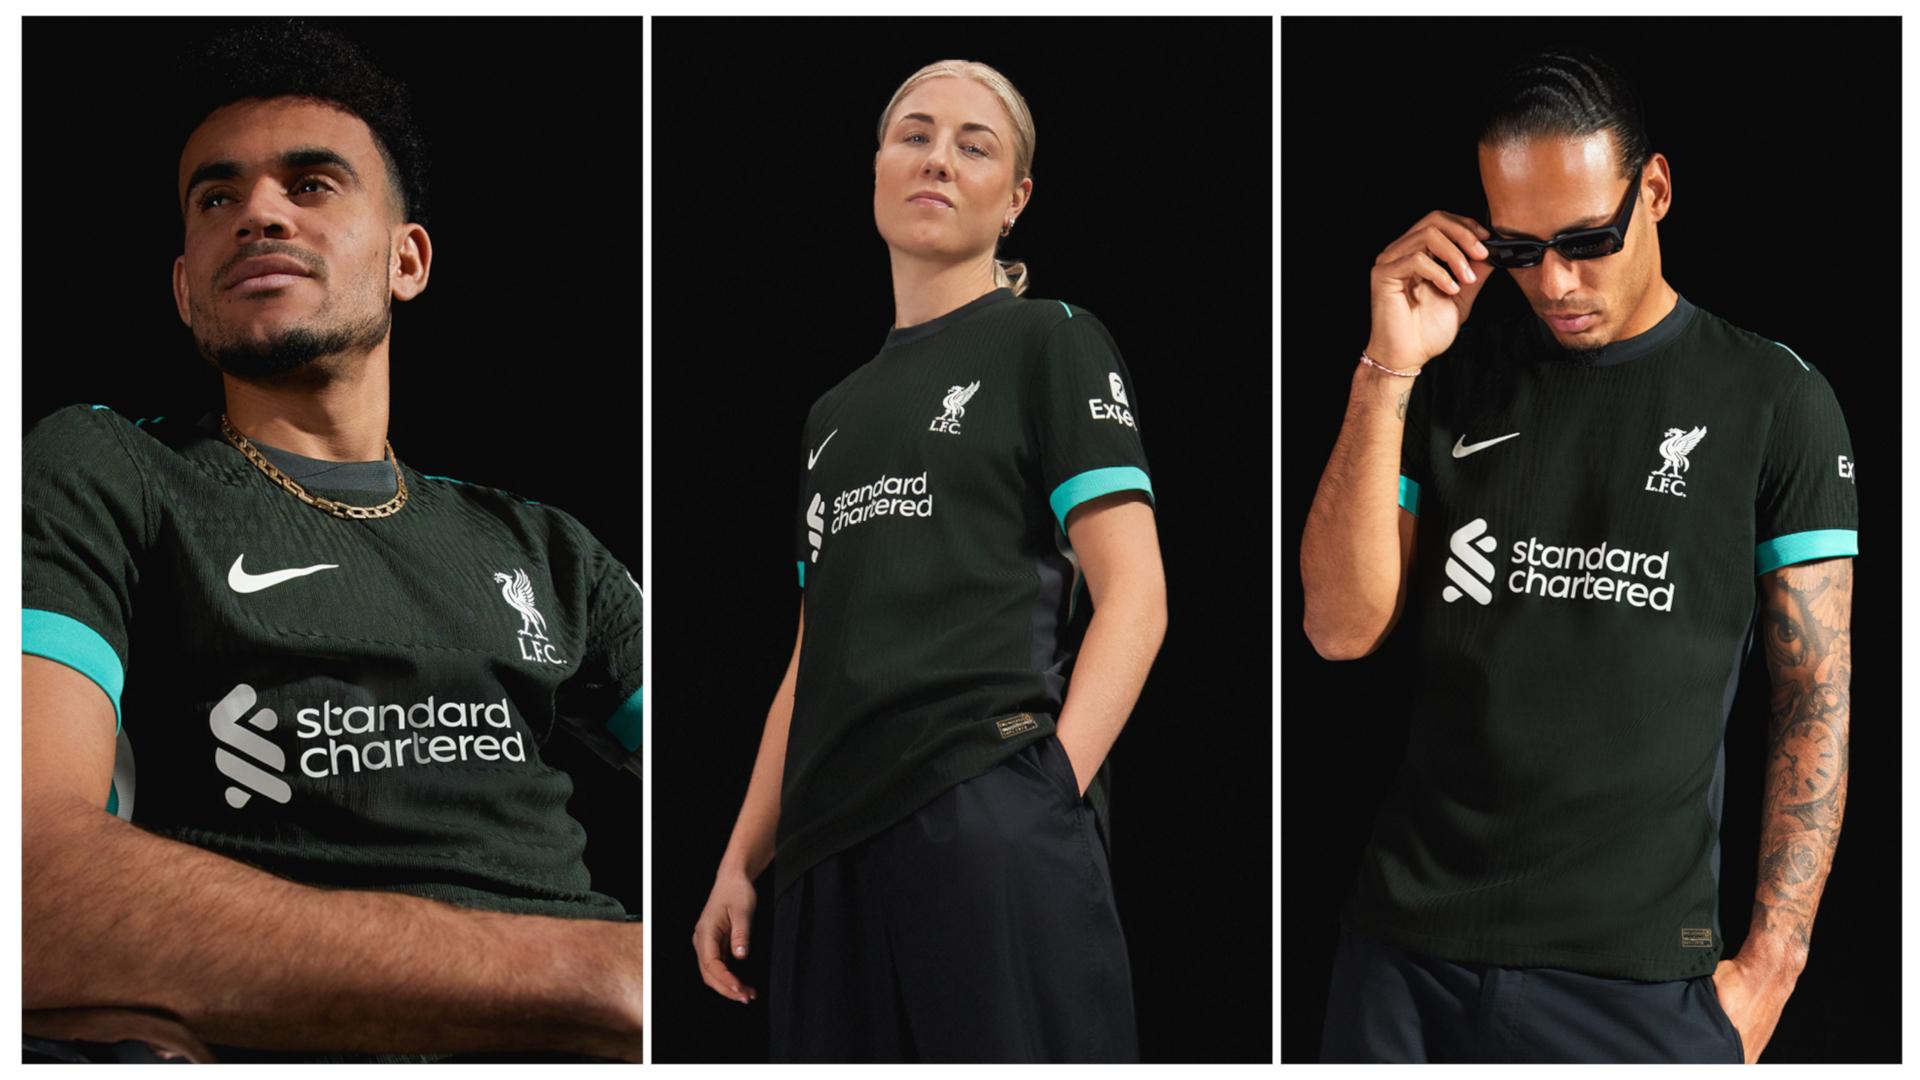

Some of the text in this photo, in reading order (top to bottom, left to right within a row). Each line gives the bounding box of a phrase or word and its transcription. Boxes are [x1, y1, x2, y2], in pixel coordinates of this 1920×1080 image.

[928, 419, 961, 435] L.F.C.
[833, 472, 928, 514] standard
[1645, 475, 1688, 498] L.F.C.
[831, 494, 933, 534] chartered
[1511, 540, 1670, 580] standard
[1508, 566, 1675, 613] chartered
[516, 636, 568, 665] L.F.C.
[297, 696, 512, 739] standard
[300, 731, 526, 778] chartered
